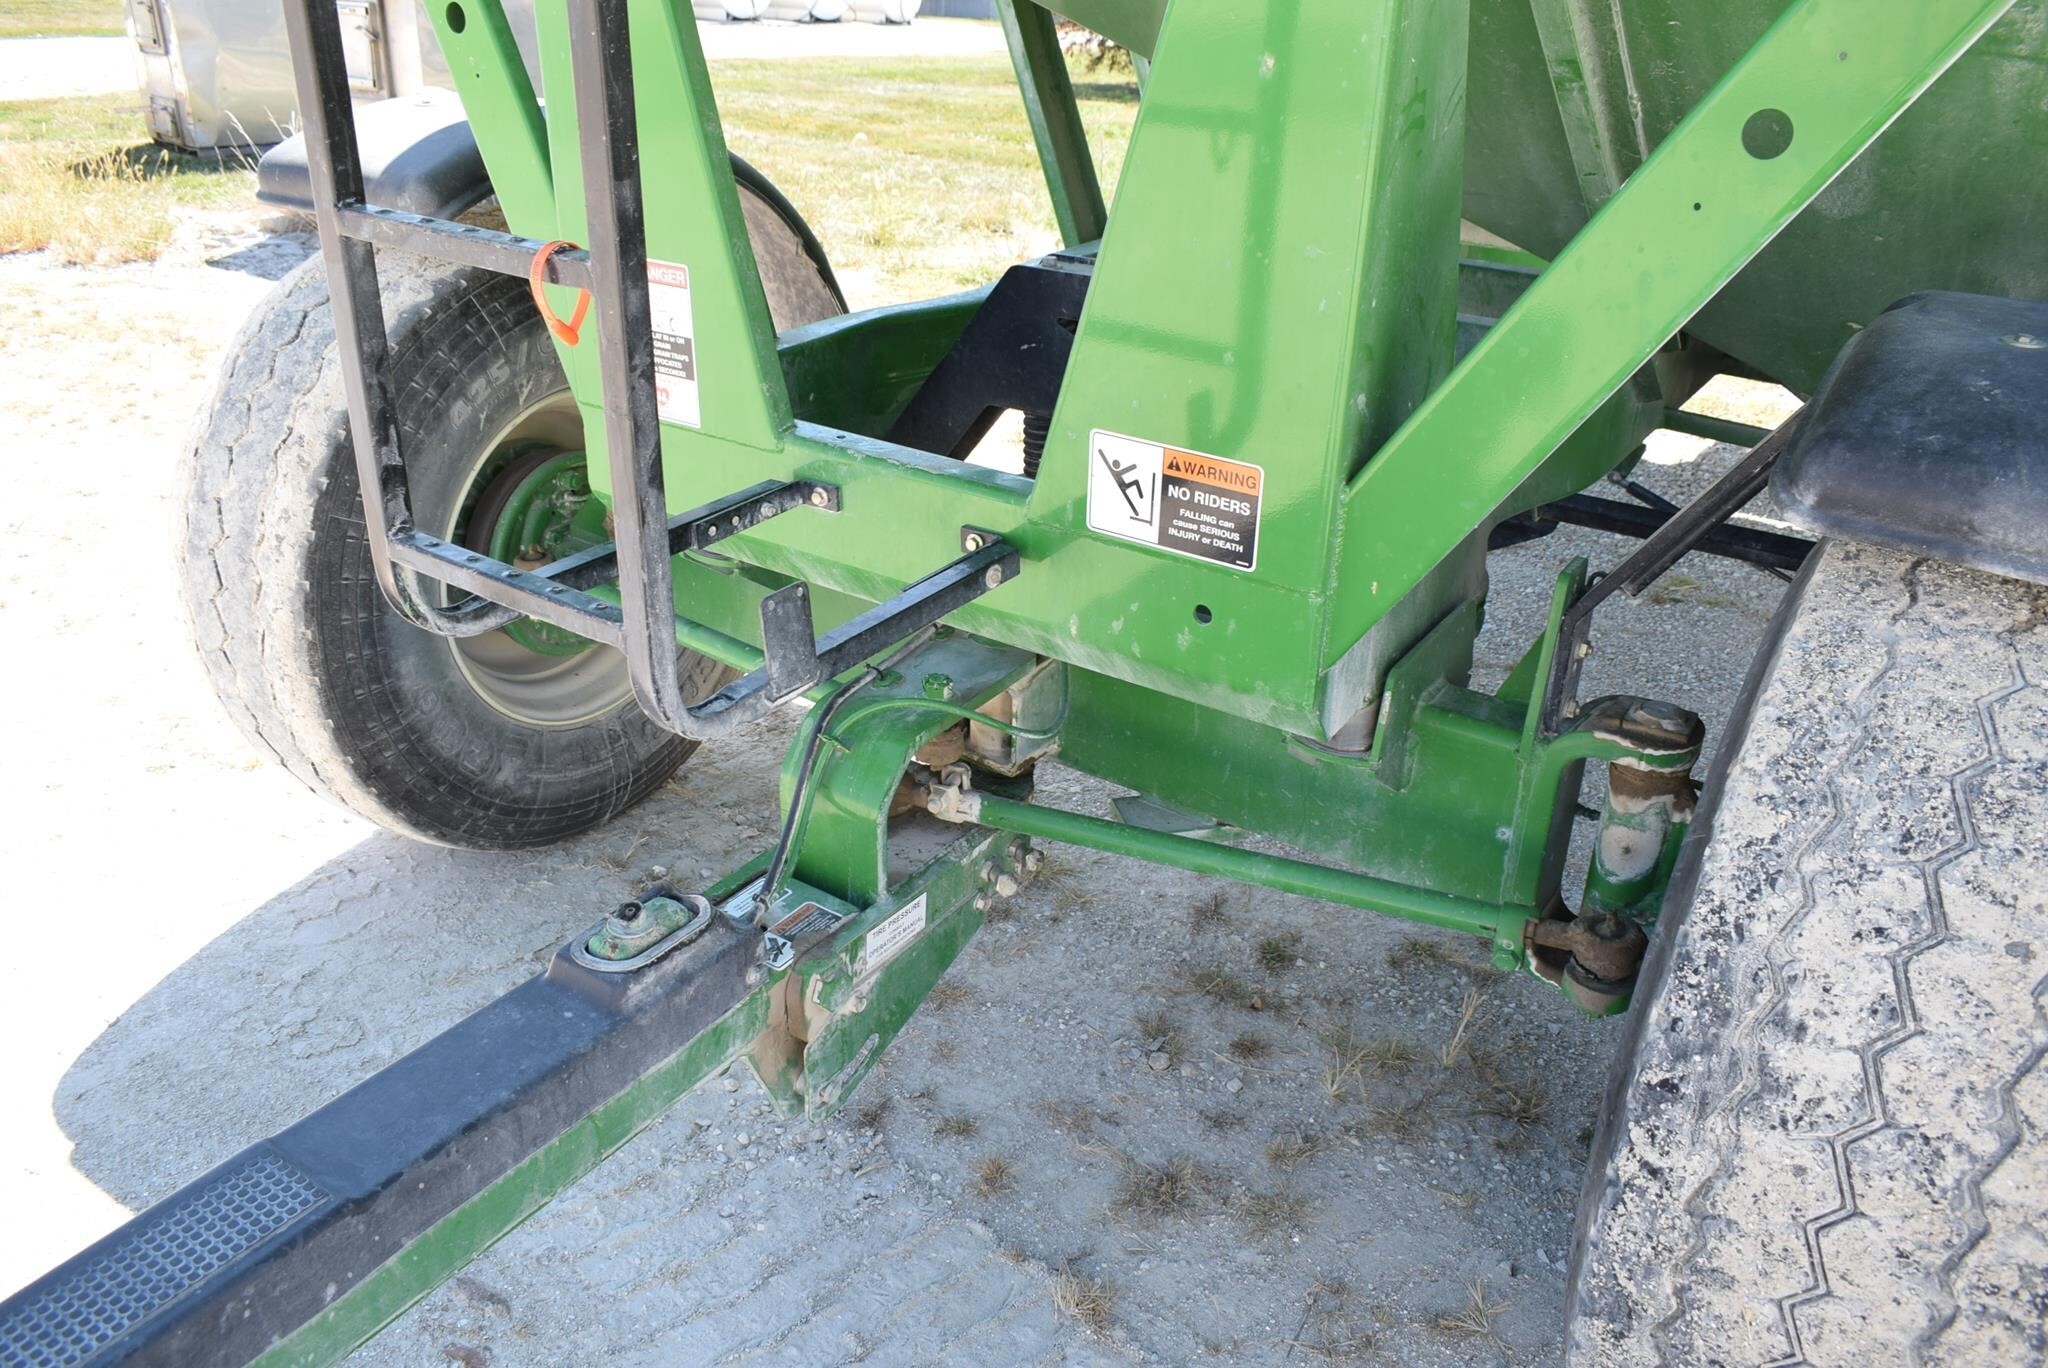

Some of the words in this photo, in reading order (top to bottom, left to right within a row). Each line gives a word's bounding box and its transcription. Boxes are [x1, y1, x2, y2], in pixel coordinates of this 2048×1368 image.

[648, 267, 685, 285] NGER
[1183, 460, 1257, 490] WARNING
[1168, 484, 1191, 501] NO
[1194, 491, 1251, 516] RIDERS
[1172, 519, 1198, 531] cause
[1199, 524, 1240, 541] SERIOUS
[1179, 508, 1217, 525] FALLING
[1218, 519, 1235, 529] can
[1168, 527, 1201, 542] INJURY
[1201, 536, 1212, 544] or
[1212, 538, 1244, 553] DEATH
[872, 924, 887, 938] TIRE
[888, 901, 920, 928] PRESSURE
[868, 930, 902, 958] OPERATOR'S
[902, 915, 924, 934] MANUAL
